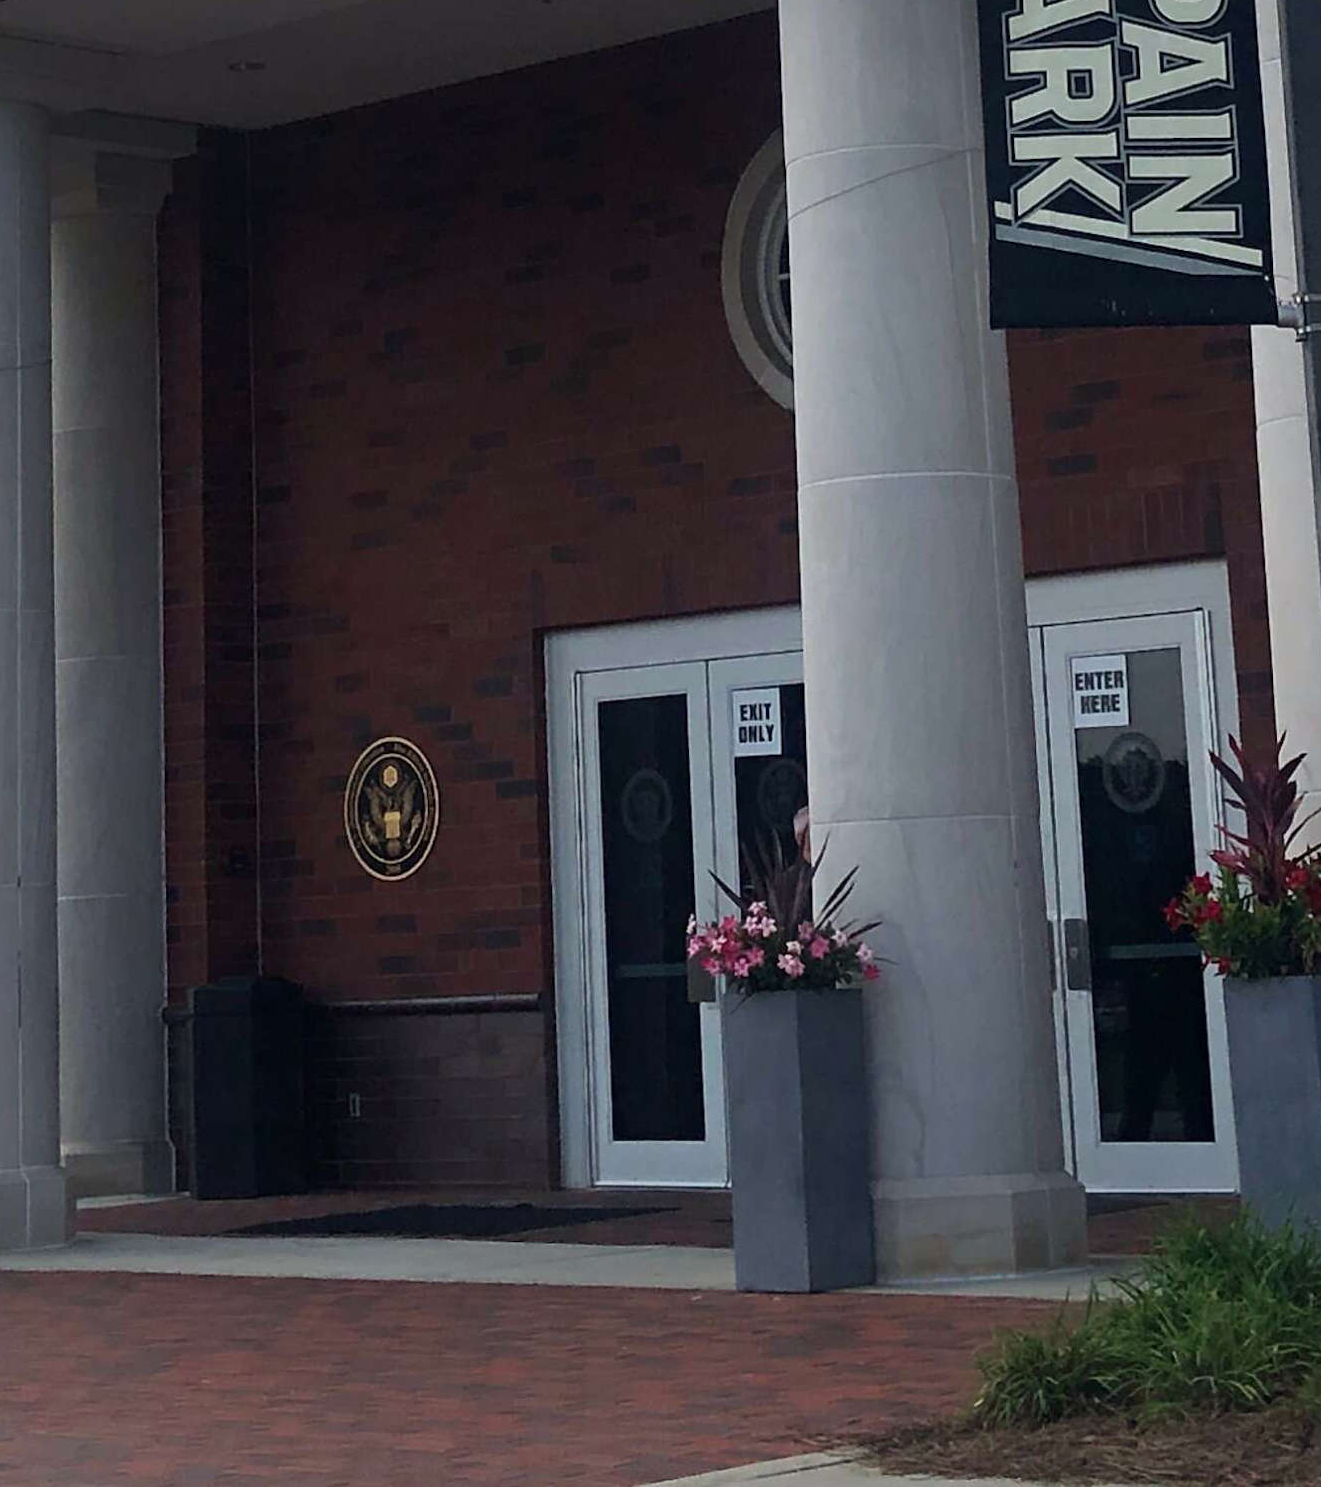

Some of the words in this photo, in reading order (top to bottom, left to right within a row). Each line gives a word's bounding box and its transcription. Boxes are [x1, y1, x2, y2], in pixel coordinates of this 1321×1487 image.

[1075, 670, 1124, 691] ENTER
[739, 702, 772, 722] EXIT
[1080, 694, 1121, 714] HERE
[738, 724, 775, 744] ONLY
